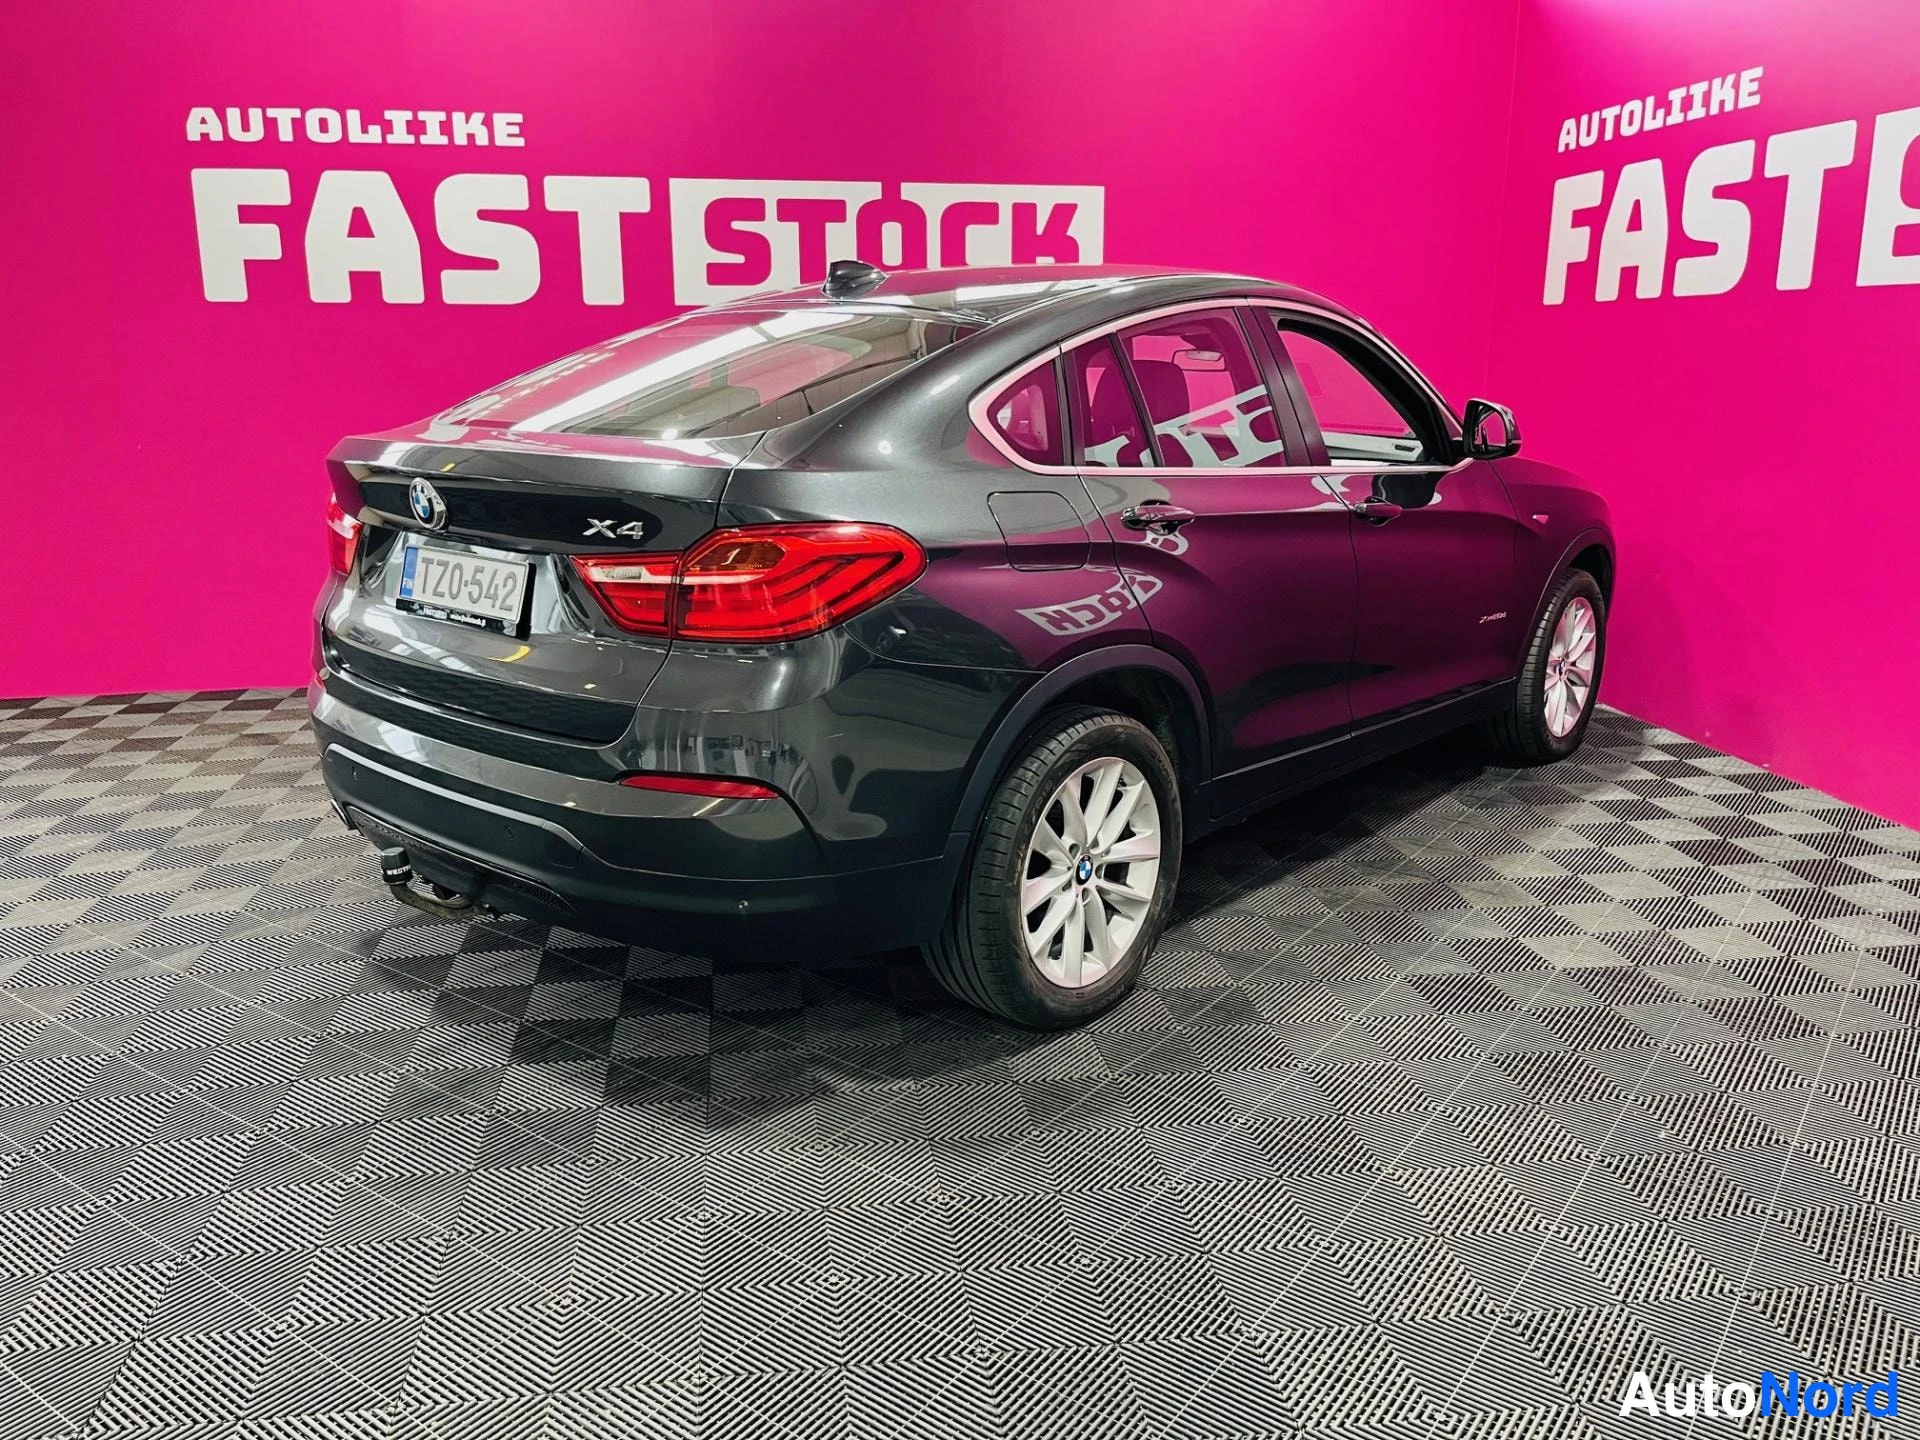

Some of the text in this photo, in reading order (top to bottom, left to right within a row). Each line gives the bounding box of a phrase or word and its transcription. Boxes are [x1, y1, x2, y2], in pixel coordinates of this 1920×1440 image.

[186, 107, 526, 147] AUTOLIIKE
[1557, 66, 1764, 153] AUTOLIIKE
[1543, 119, 1858, 305] FAST
[582, 518, 643, 540] X4
[421, 556, 517, 612] TZO-542
